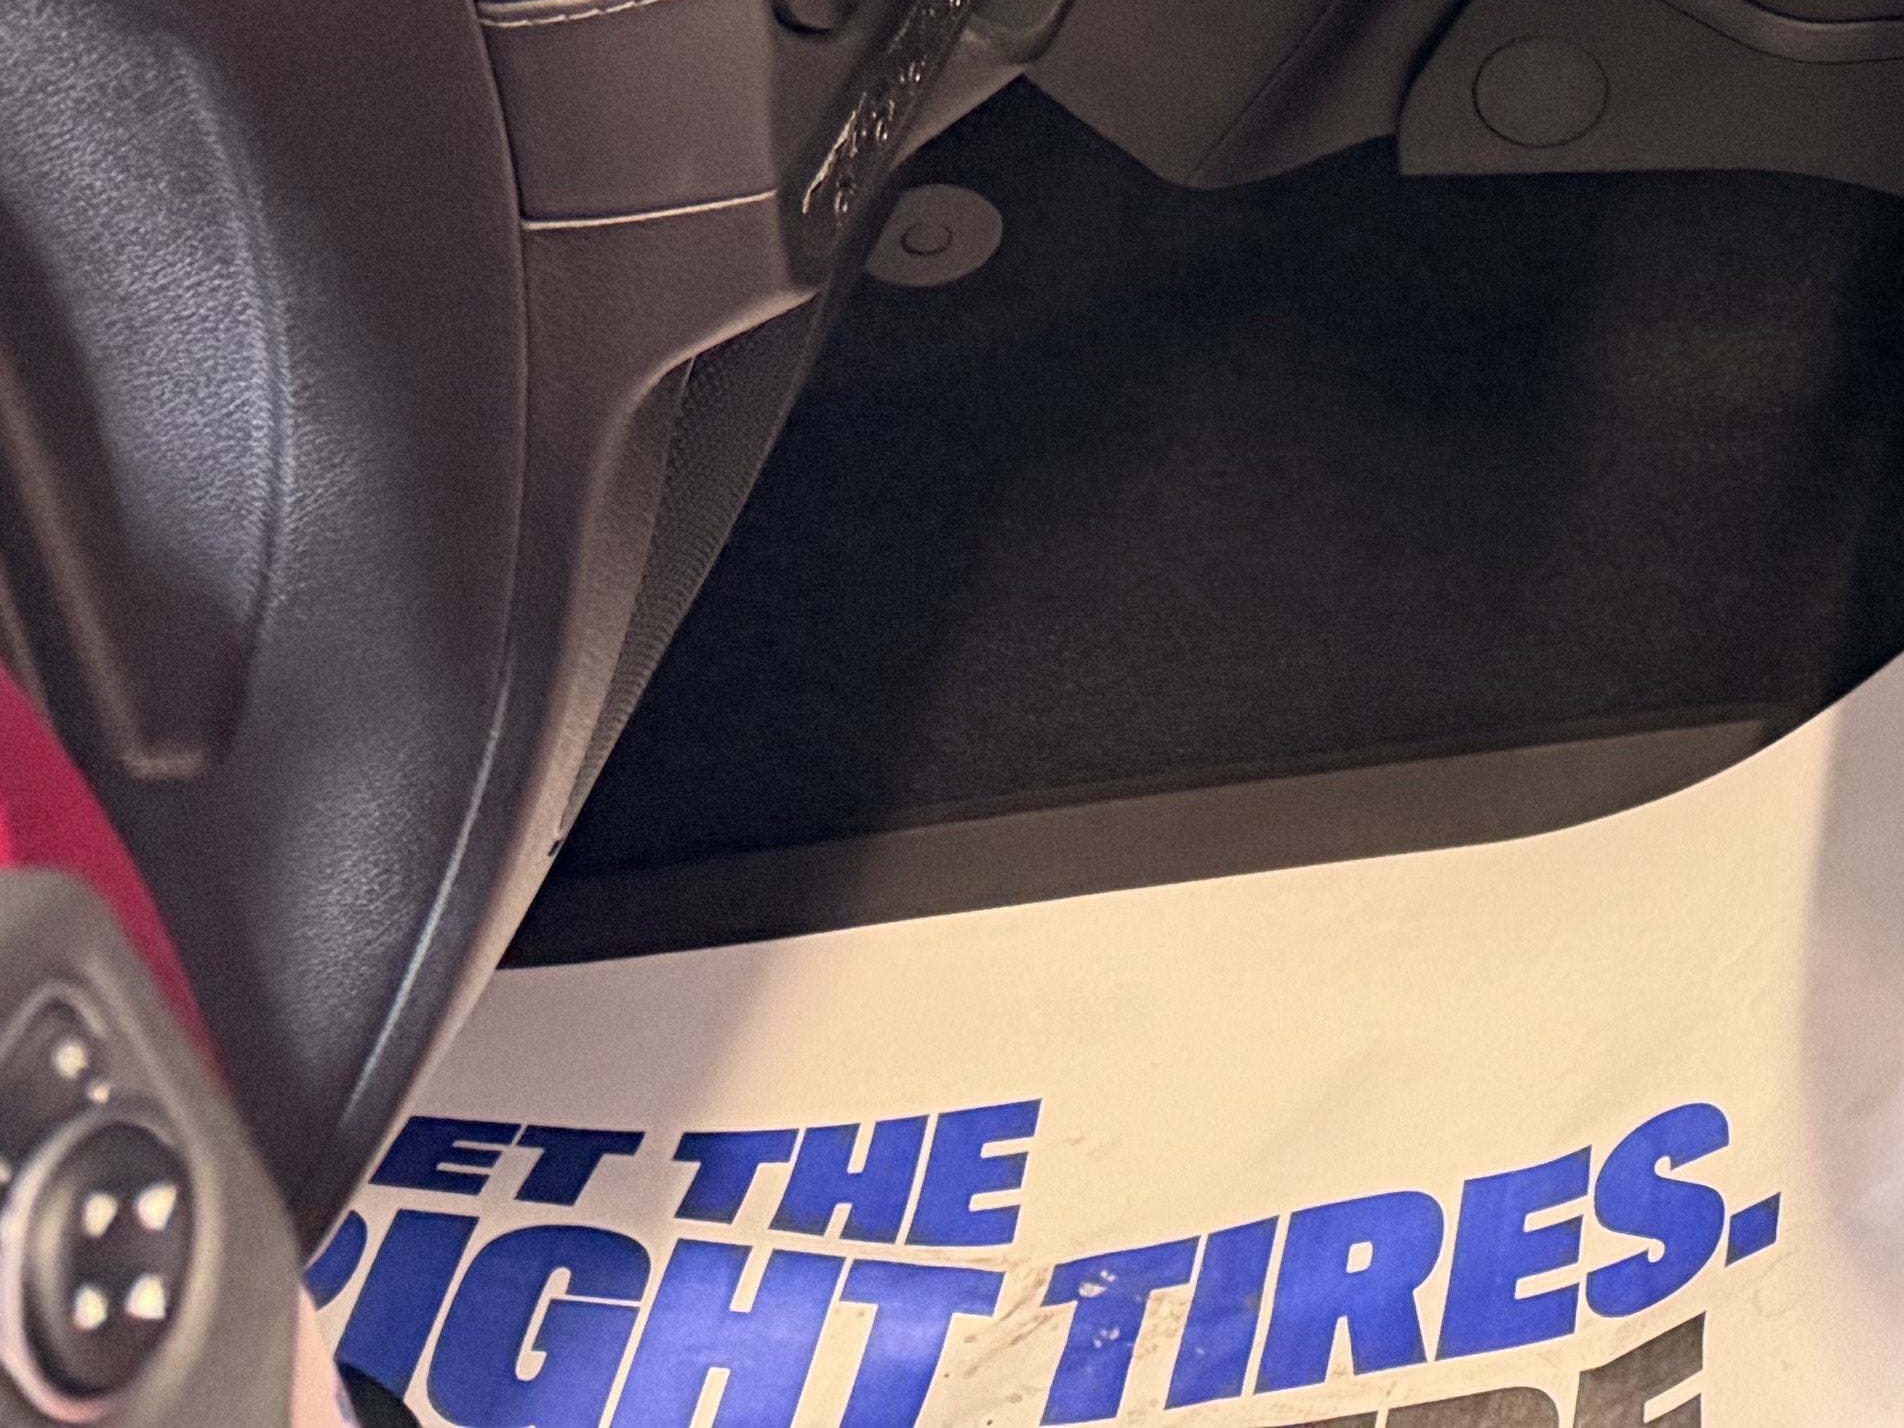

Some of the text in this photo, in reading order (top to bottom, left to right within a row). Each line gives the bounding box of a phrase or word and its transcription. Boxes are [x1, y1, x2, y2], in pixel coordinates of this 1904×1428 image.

[367, 1098, 1044, 1247] ET THE
[1039, 1101, 1782, 1426] TIRES.
